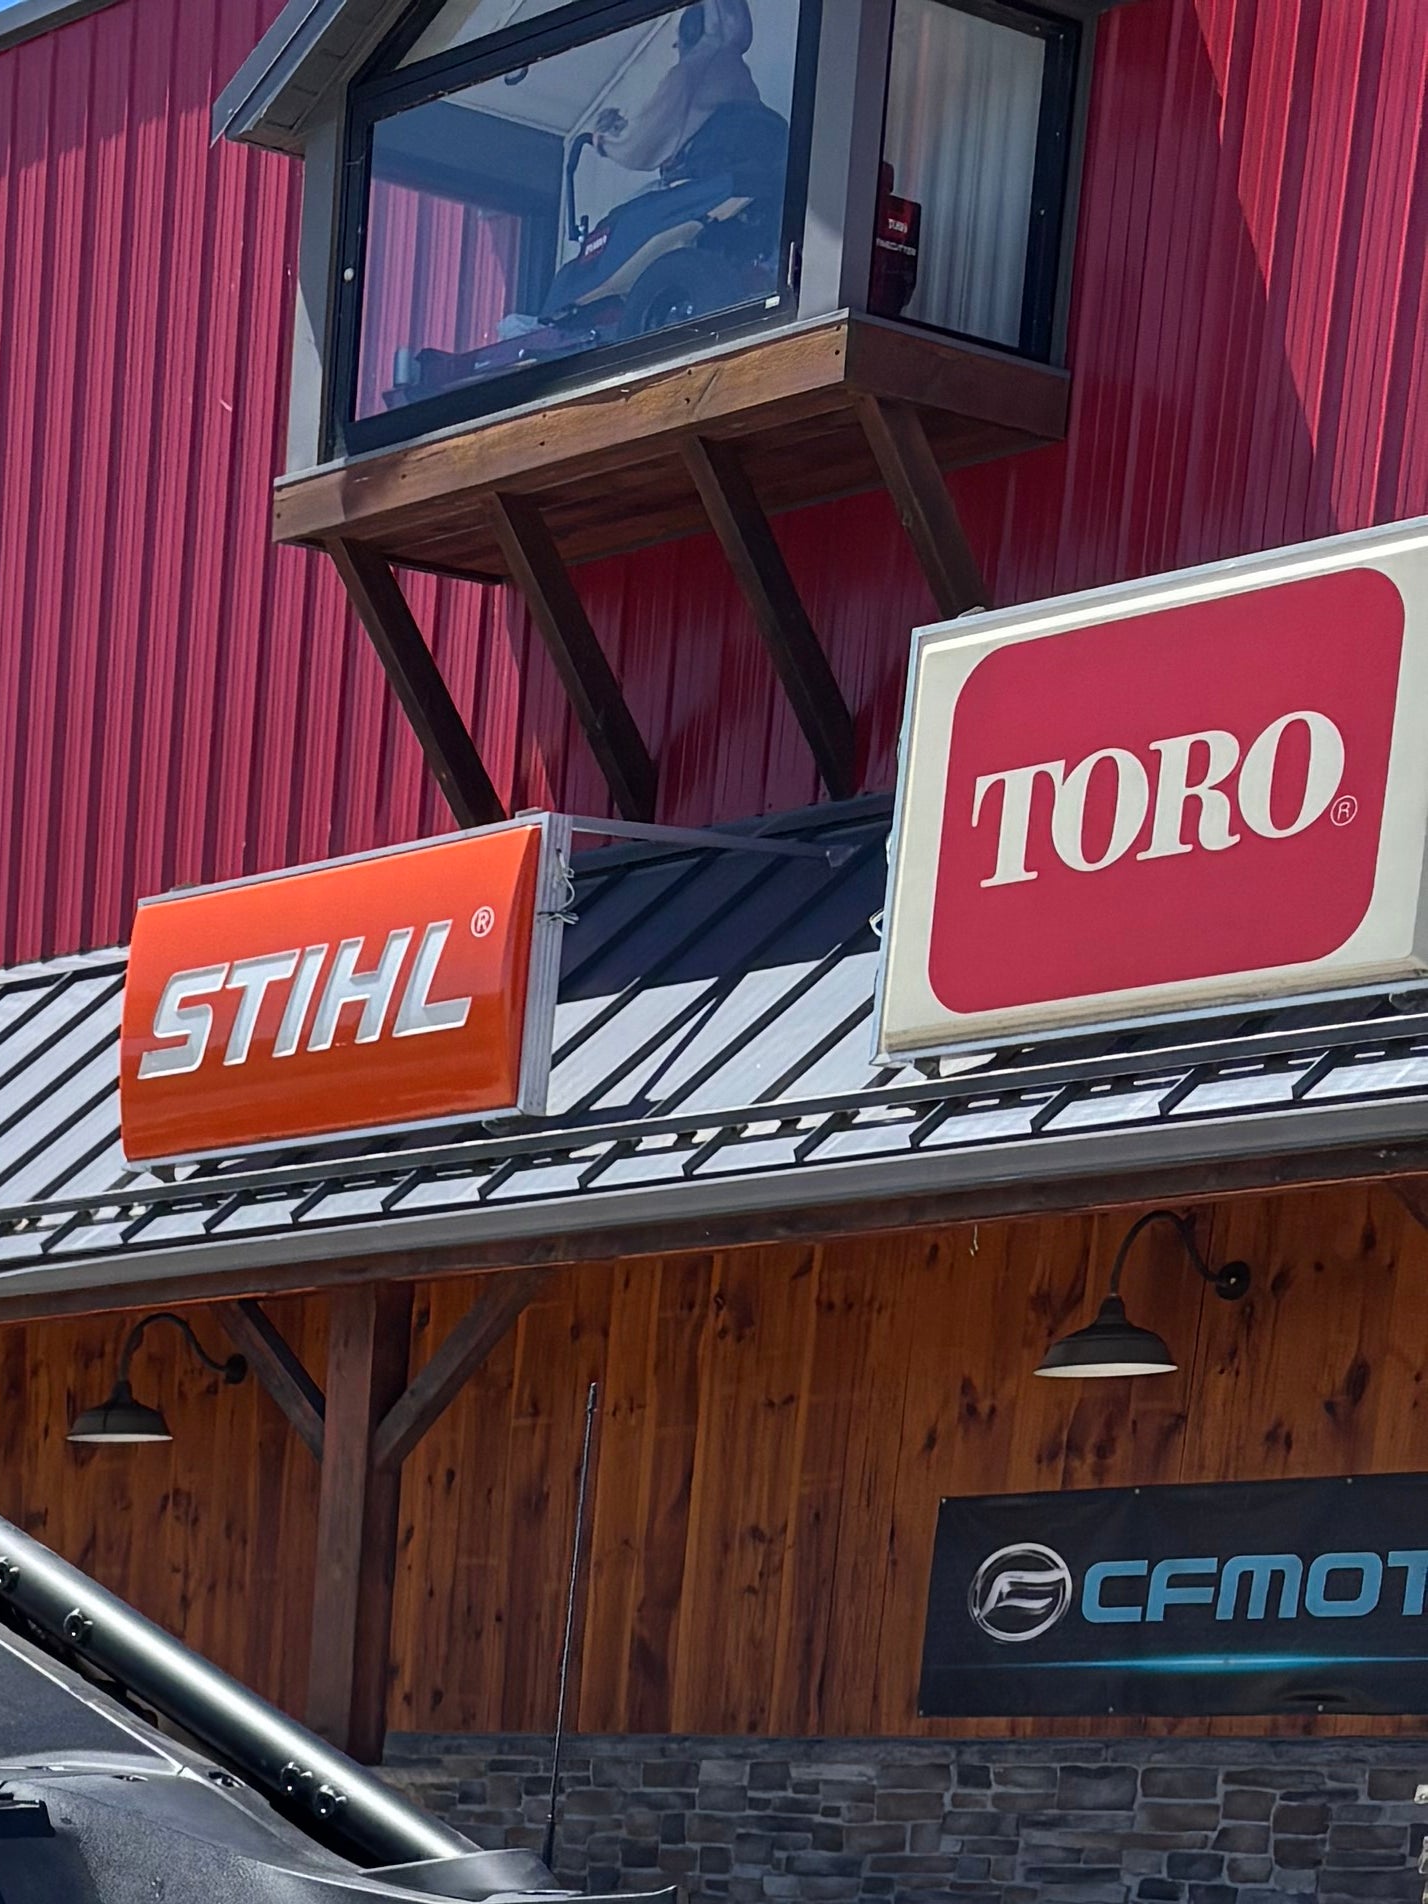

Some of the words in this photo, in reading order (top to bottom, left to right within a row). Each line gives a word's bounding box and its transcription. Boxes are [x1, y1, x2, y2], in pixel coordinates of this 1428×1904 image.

[972, 709, 1346, 889] TORO
[138, 917, 475, 1080] STIHL
[1081, 1550, 1428, 1623] CFMOT
